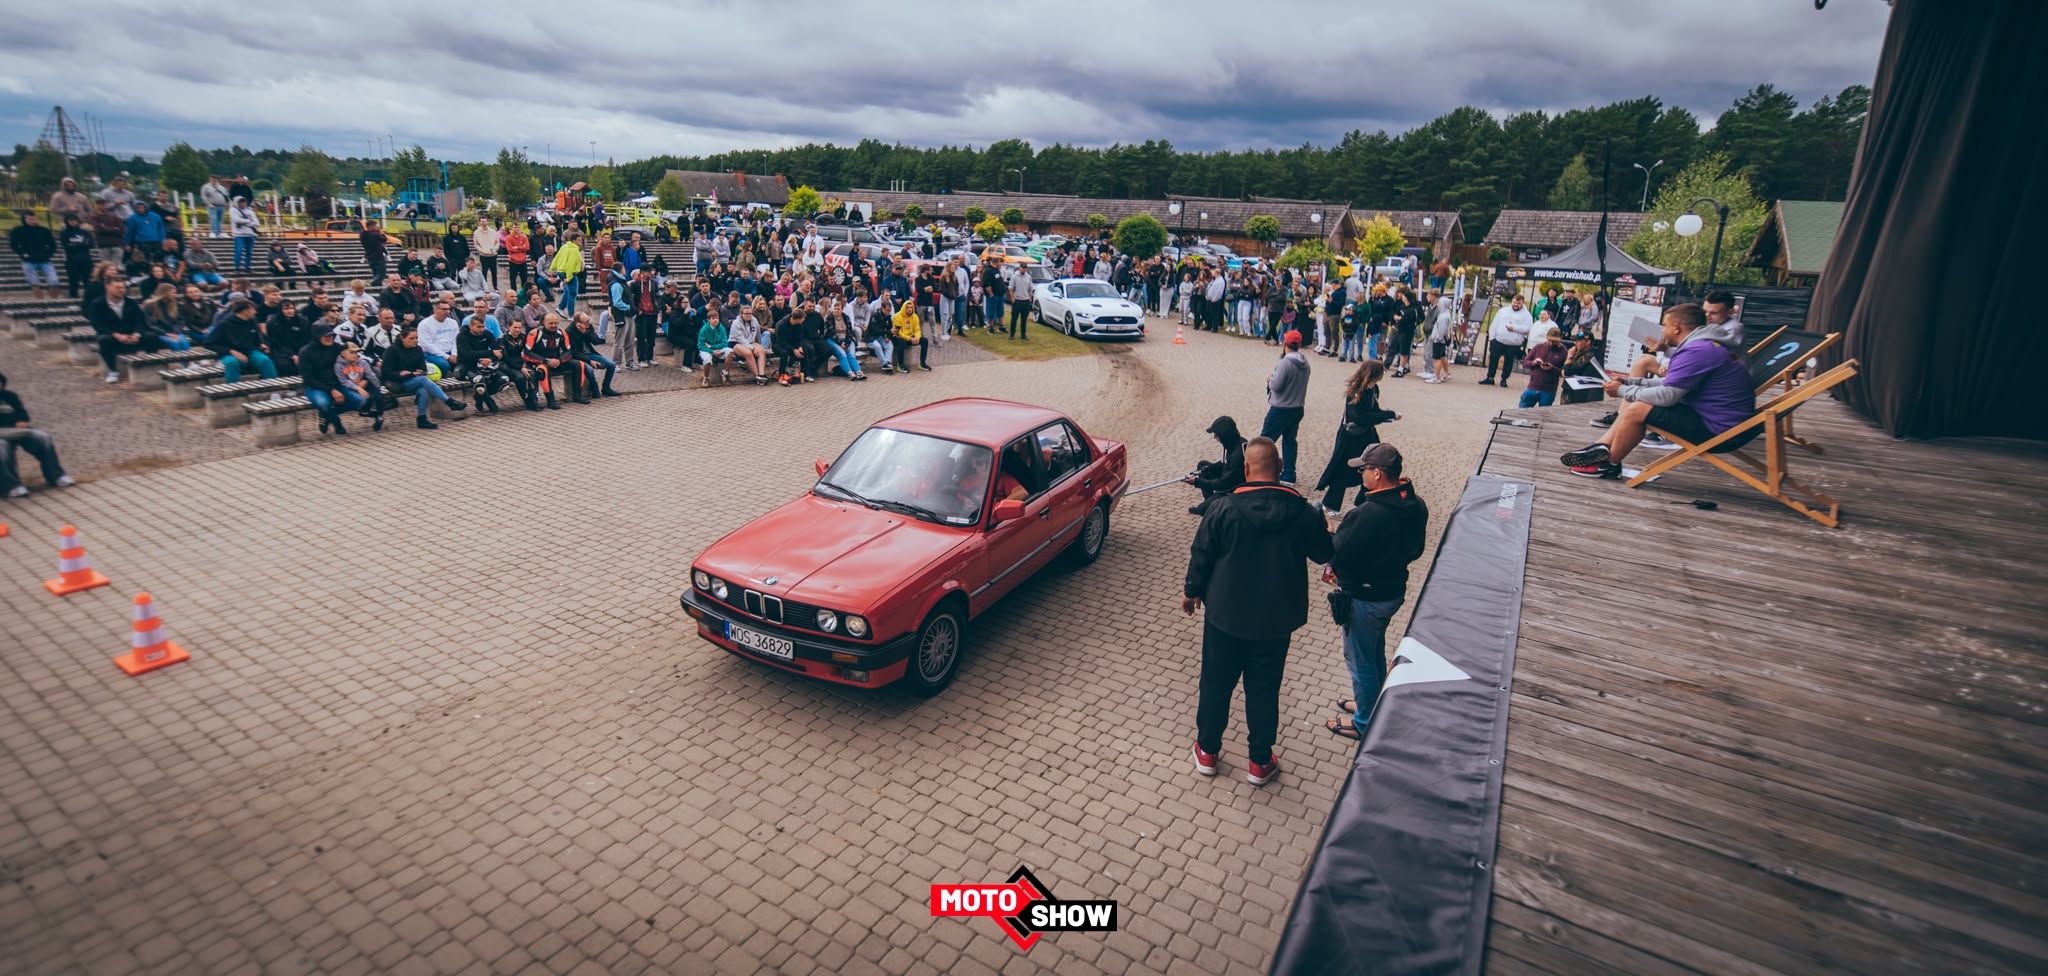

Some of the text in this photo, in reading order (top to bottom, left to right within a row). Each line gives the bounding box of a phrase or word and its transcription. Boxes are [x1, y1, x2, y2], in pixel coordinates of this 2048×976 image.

[1534, 269, 1602, 283] www.serwishub.p
[730, 624, 791, 656] WOS 36829
